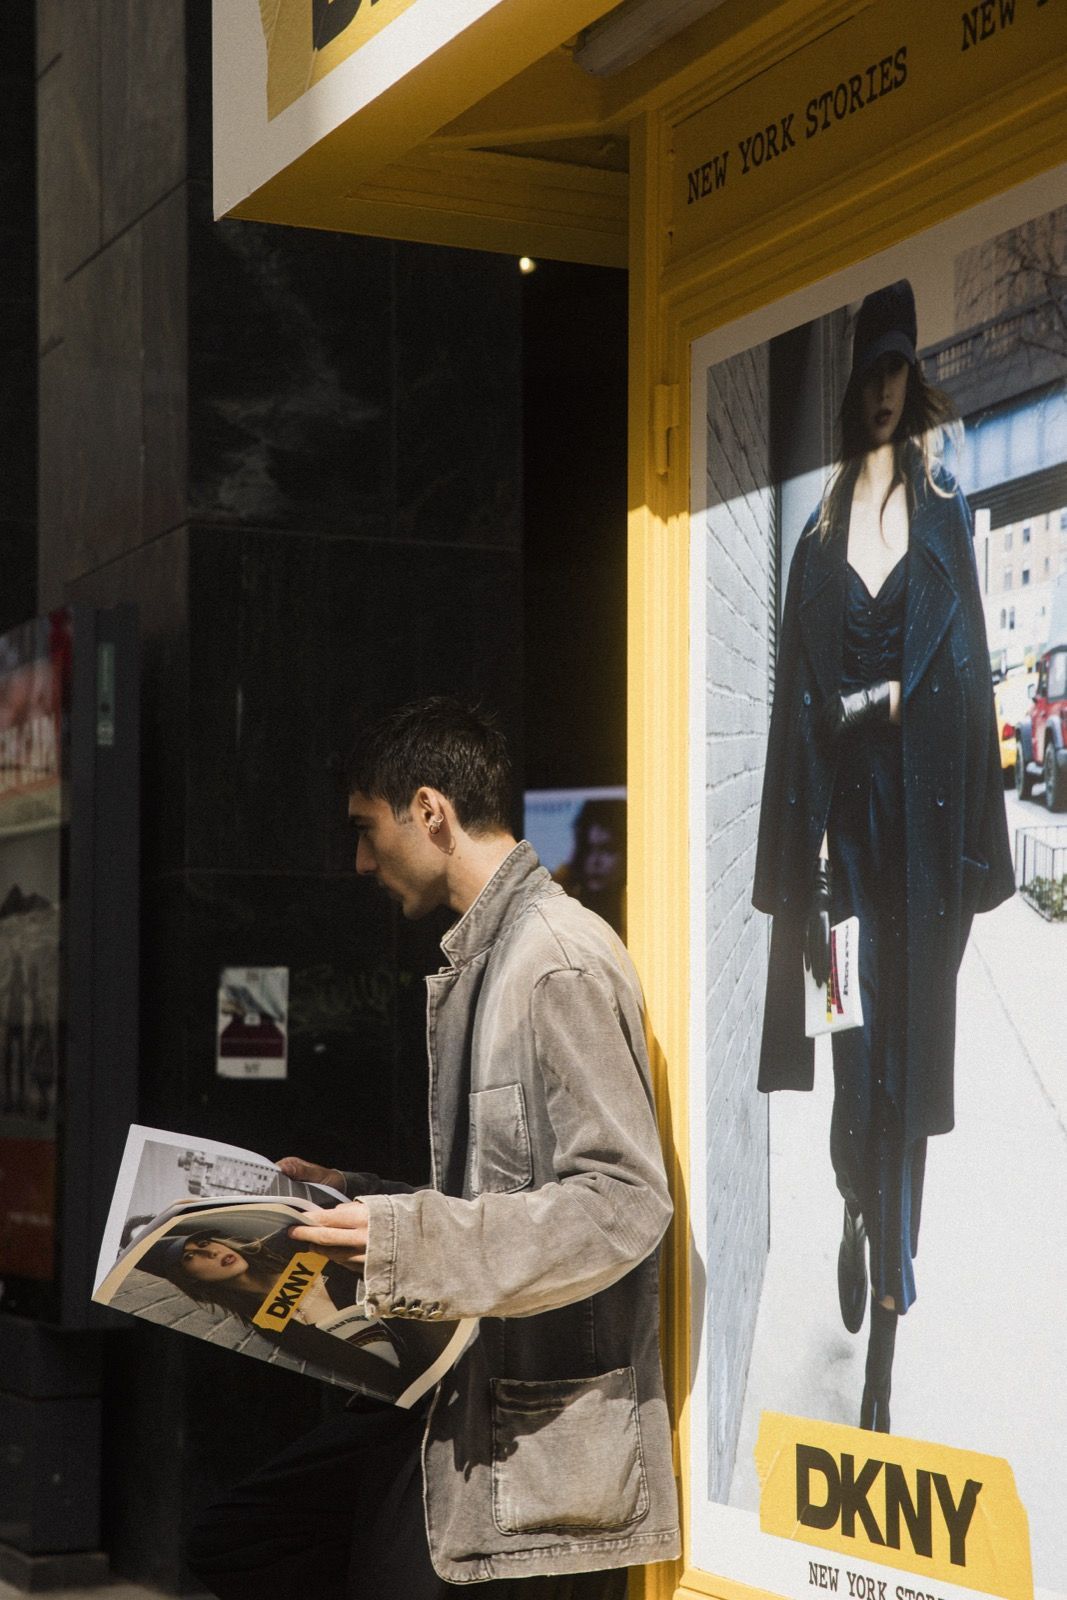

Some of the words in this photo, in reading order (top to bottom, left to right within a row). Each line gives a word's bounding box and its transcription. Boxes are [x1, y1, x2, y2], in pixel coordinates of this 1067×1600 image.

[961, 0, 1016, 51] NEW
[687, 151, 729, 205] NEW
[738, 113, 796, 175] YORK
[805, 46, 908, 139] STORIES
[265, 1261, 316, 1319] DKNY
[795, 1443, 983, 1568] DKNY
[808, 1561, 840, 1592] NEW
[846, 1571, 888, 1600] YORK
